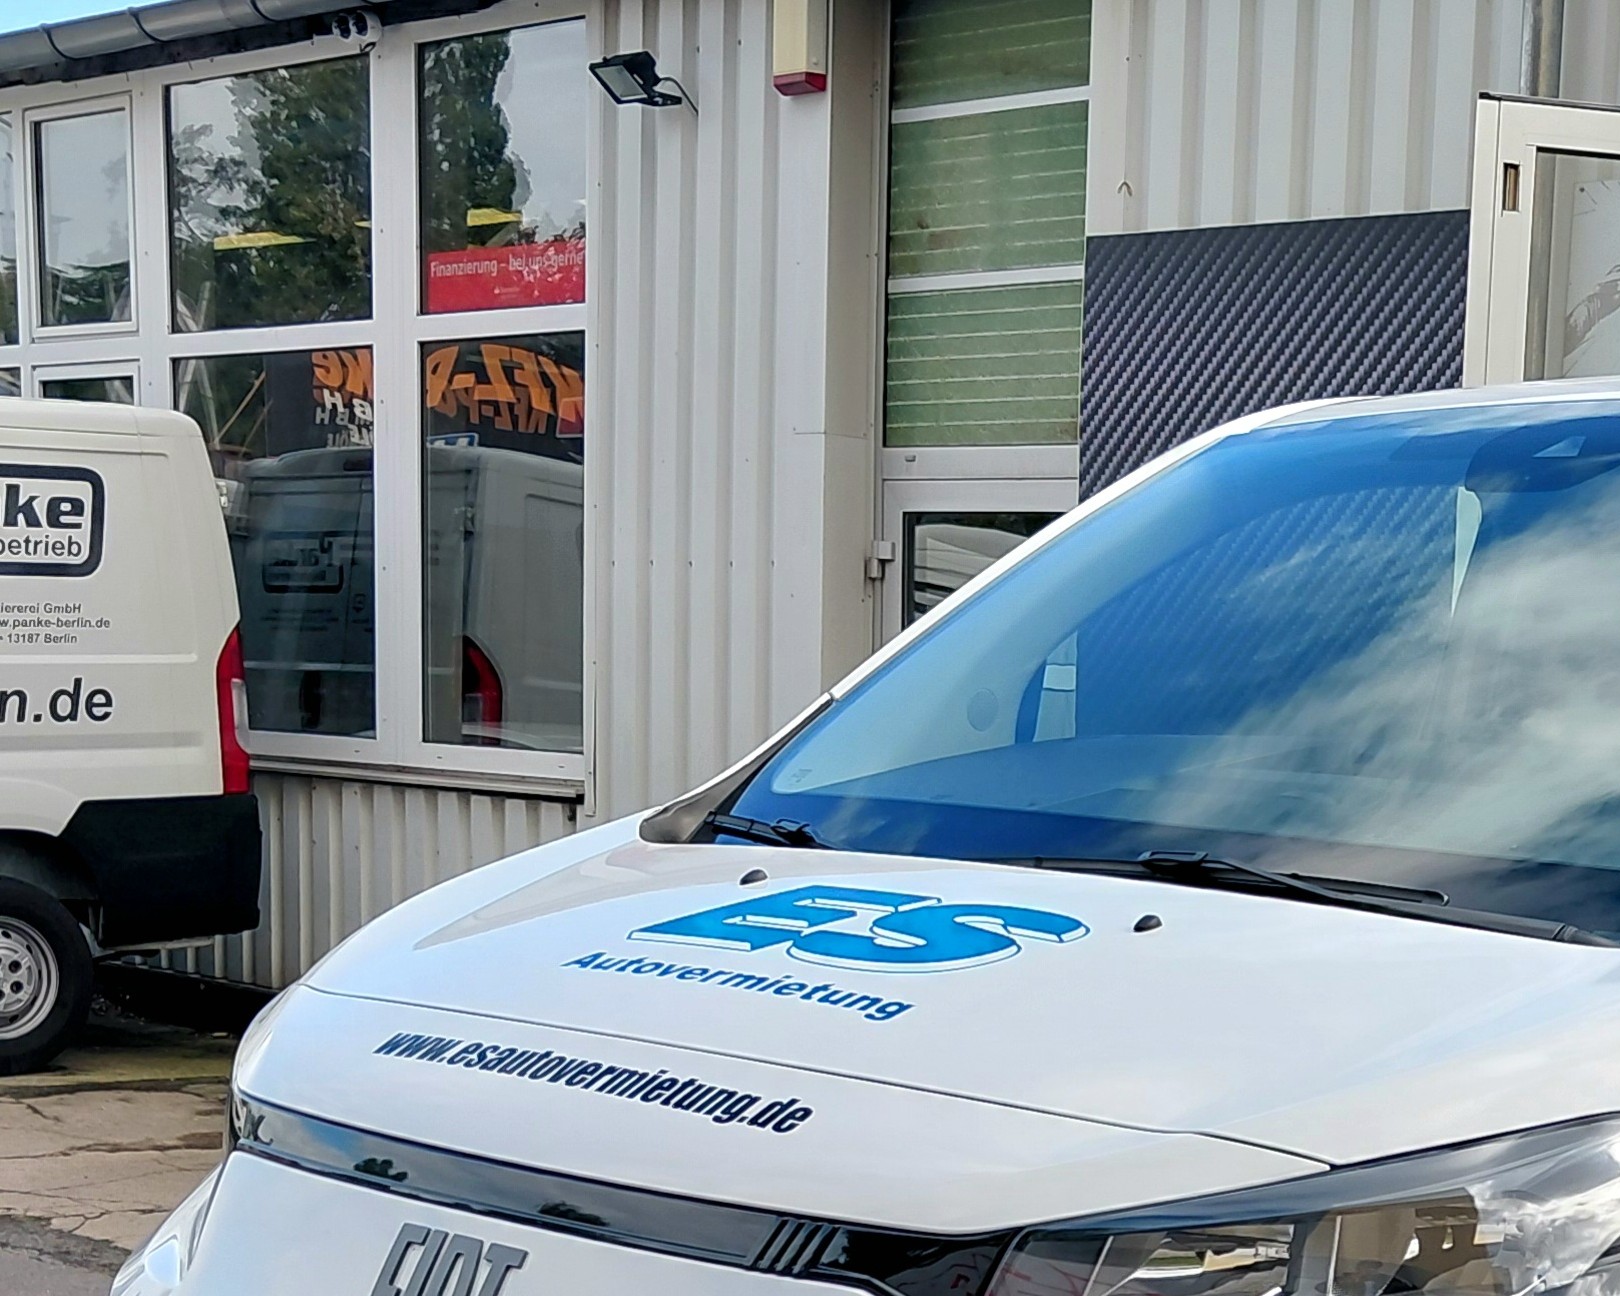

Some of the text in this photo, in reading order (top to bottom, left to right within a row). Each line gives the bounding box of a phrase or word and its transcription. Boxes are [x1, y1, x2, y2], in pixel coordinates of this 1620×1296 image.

[430, 259, 498, 277] Finanzierung
[43, 602, 82, 614] GmbH
[6, 633, 78, 644] 13187 Berlin
[626, 885, 1092, 973] ES
[560, 950, 916, 1022] Autovermietung
[373, 1030, 815, 1135] www.esautovermietung.de
